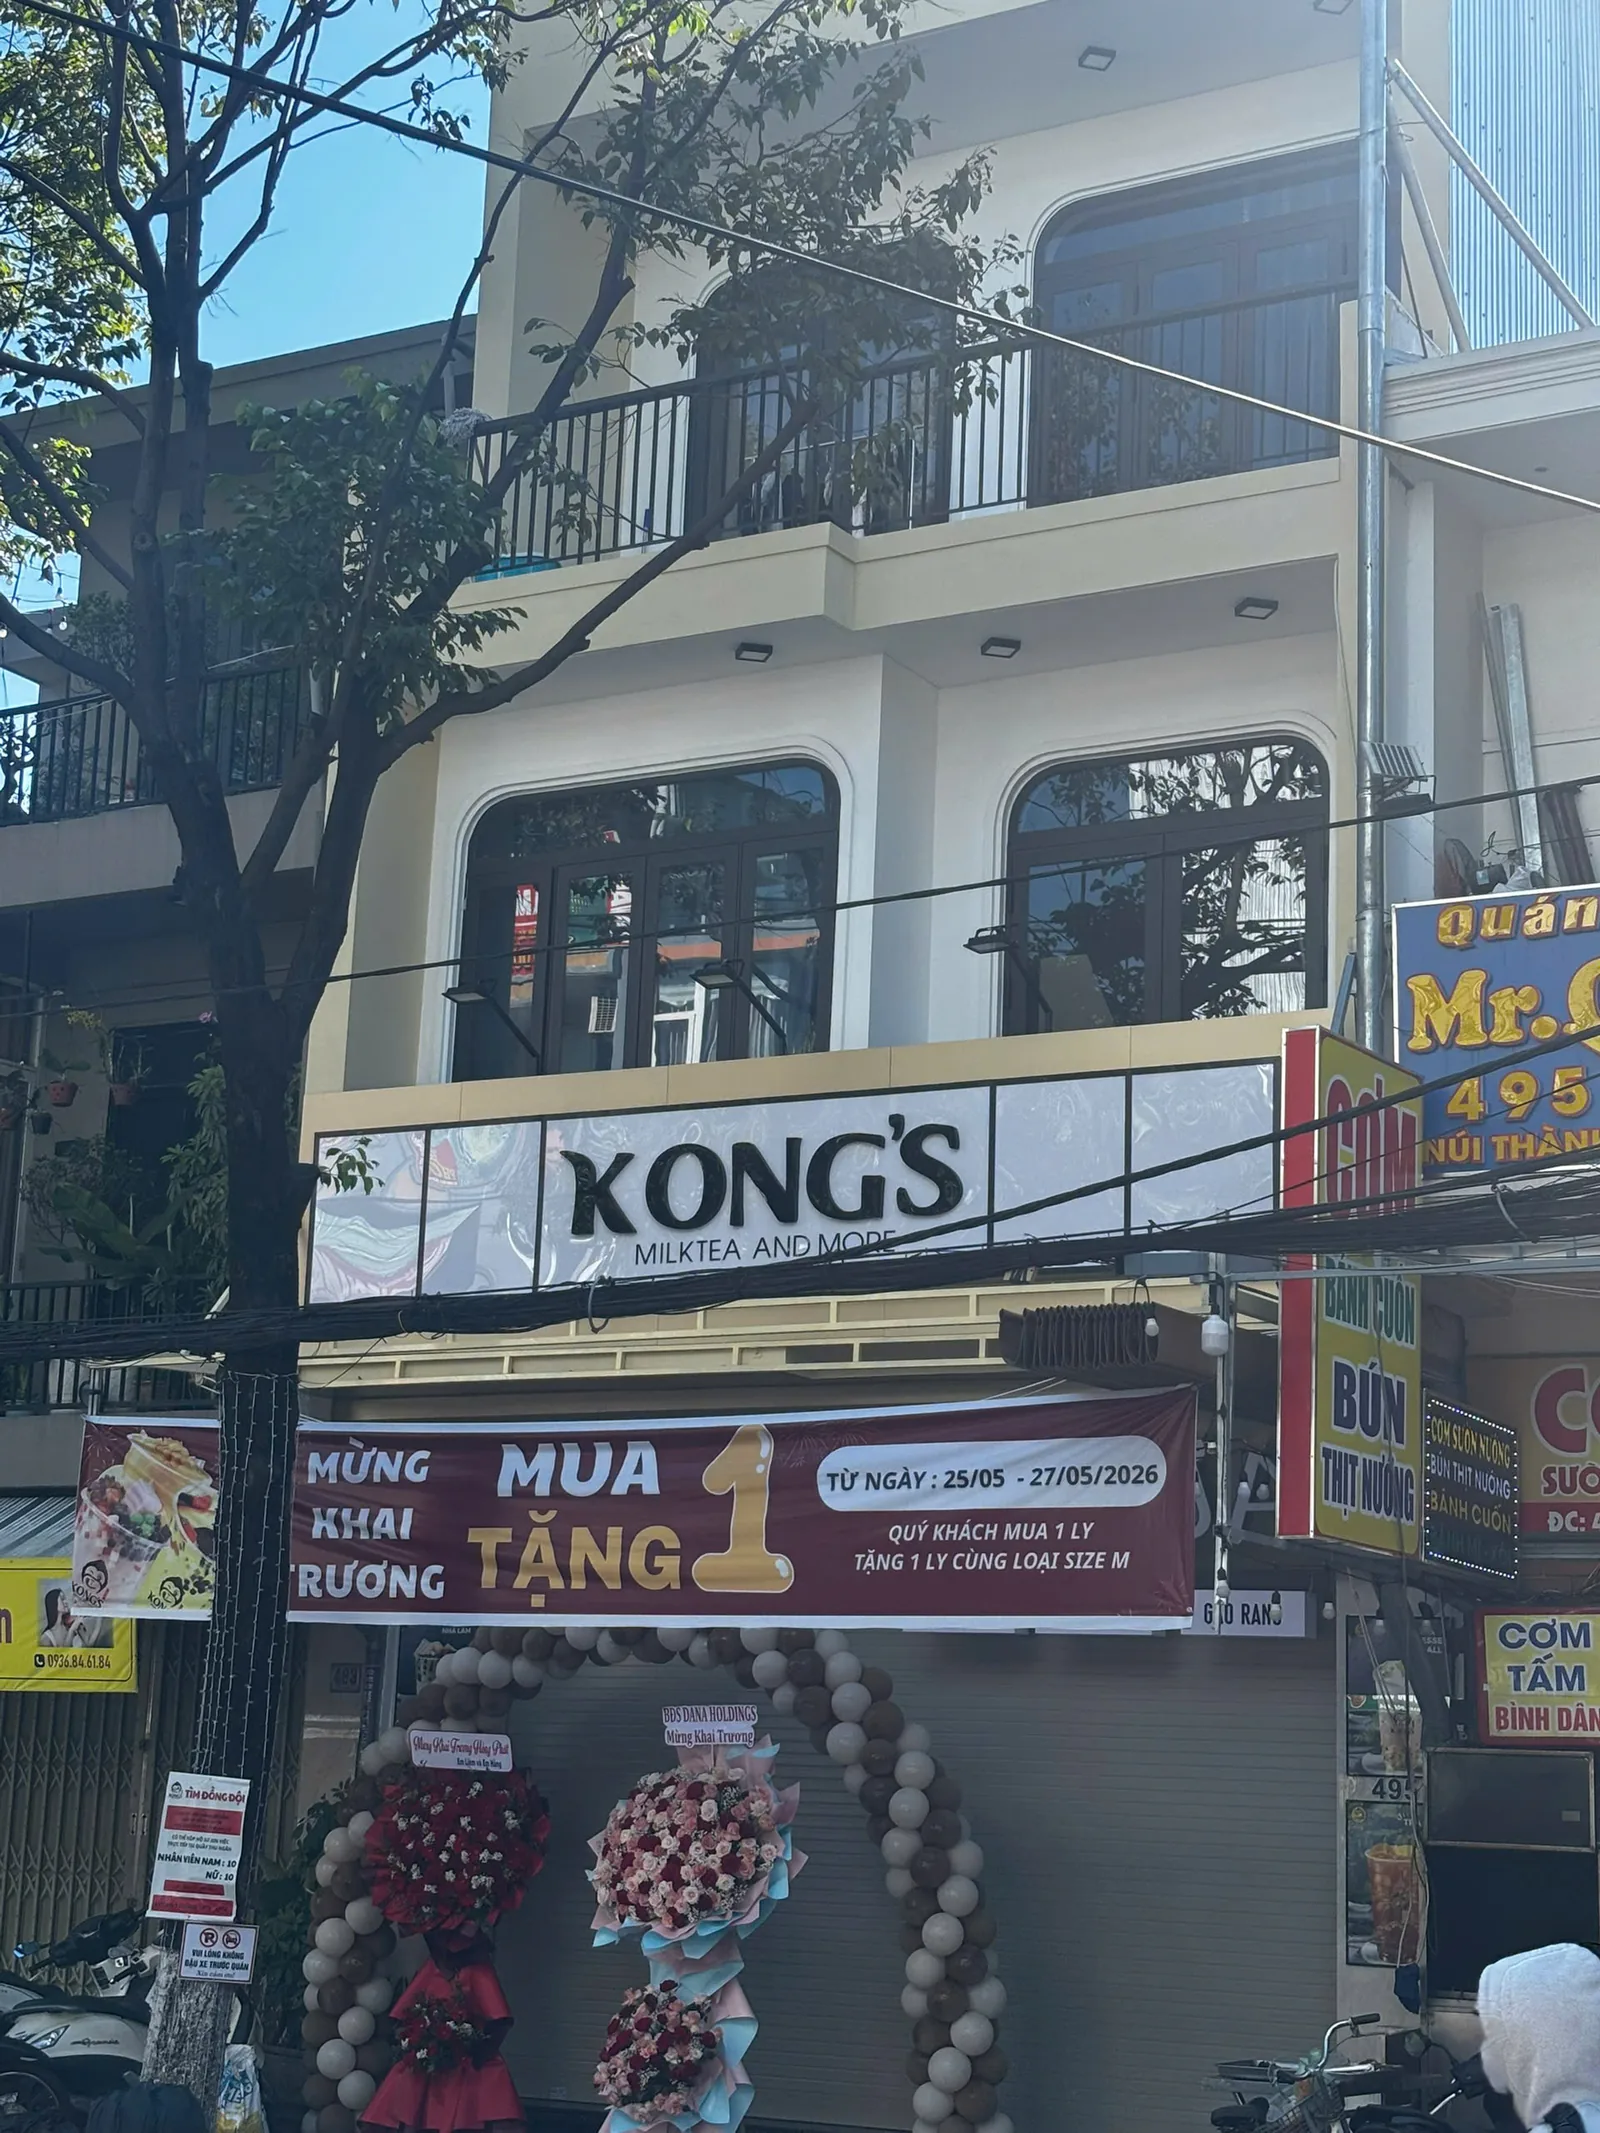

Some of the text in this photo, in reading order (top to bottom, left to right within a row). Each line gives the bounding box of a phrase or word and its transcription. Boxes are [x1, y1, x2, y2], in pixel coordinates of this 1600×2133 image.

[1436, 892, 1600, 950] Quán
[1424, 1129, 1484, 1164] NÚI
[559, 1112, 962, 1237] KONG'S
[635, 1238, 741, 1265] MILKTEA
[753, 1234, 811, 1259] AND
[1333, 1361, 1405, 1445] BÚN
[1534, 1367, 1600, 1454] C
[306, 1437, 431, 1485] MỪNG
[496, 1440, 661, 1498] MUA
[1431, 1451, 1450, 1480] BÚN
[827, 1468, 858, 1491] TỪ
[865, 1467, 928, 1491] NGÀY
[943, 1469, 1005, 1489] 25/05
[1029, 1464, 1158, 1486] 27/05/2026
[1322, 1446, 1358, 1517] THỊT
[311, 1506, 414, 1541] KHAI
[466, 1424, 795, 1608] TẶNG 1
[888, 1519, 1095, 1544] QUÝ KHÁCH MUA 1 LY
[1472, 1504, 1511, 1535] CUỐN
[854, 1547, 1131, 1578] TẶNG 1 LY CÙNG LOẠI SIZE M
[1499, 1618, 1591, 1649] CƠM
[47, 1653, 111, 1669] 0936.84.61.84
[1507, 1652, 1585, 1692] TẤM
[663, 1705, 757, 1723] BĐS DANA HOLDINGS
[1495, 1701, 1550, 1731] BÌNH
[666, 1729, 693, 1746] Mừng
[694, 1728, 716, 1744] Khai
[185, 1786, 200, 1799] TÌM
[201, 1786, 228, 1802] ĐỒNG
[157, 1852, 182, 1863] NHÂN
[183, 1853, 200, 1865] VIÊN
[201, 1857, 221, 1867] NAM
[226, 1860, 237, 1868] 10
[224, 1873, 234, 1881] 10
